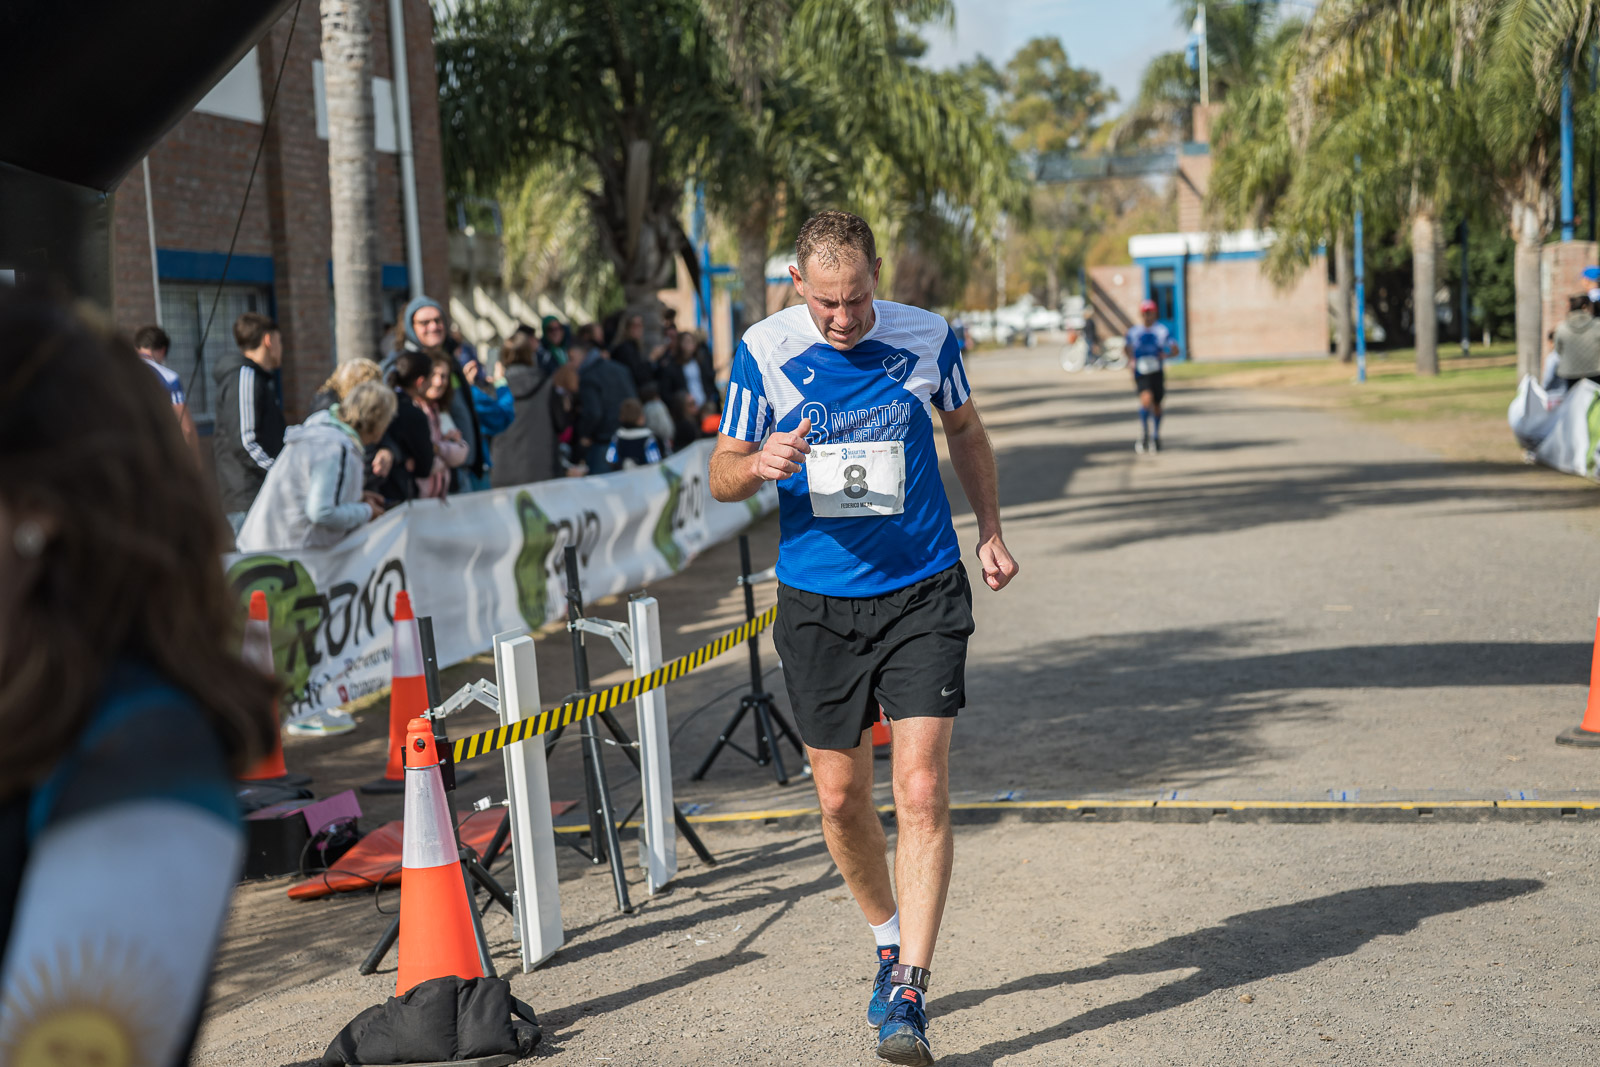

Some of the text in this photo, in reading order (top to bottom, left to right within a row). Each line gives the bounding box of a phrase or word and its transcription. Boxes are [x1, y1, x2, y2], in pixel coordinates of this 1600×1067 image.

[801, 401, 829, 445] 3
[831, 399, 911, 432] MARATÓN
[841, 447, 848, 461] 3
[844, 464, 869, 499] 8
